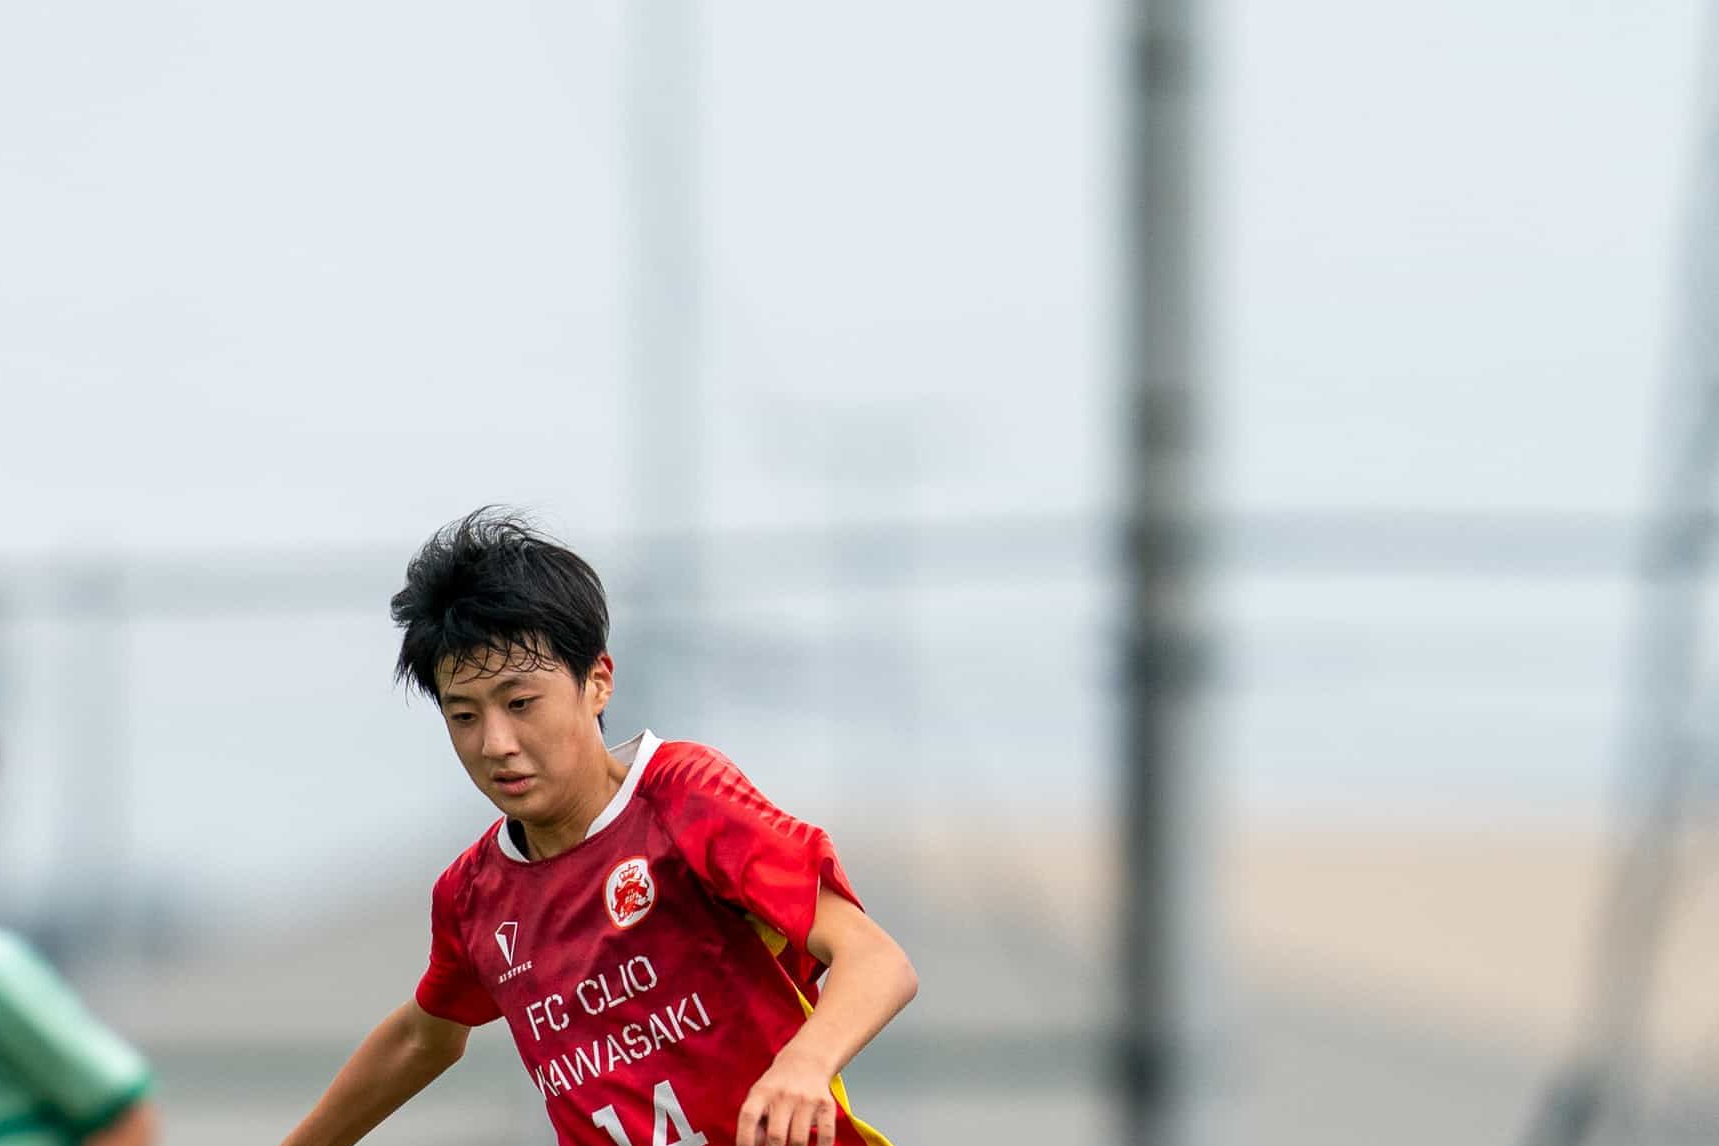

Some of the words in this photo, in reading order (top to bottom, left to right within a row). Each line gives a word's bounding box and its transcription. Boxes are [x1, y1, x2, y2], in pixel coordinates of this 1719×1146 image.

[526, 993, 570, 1041] FC
[575, 955, 658, 1016] CLIO
[535, 992, 712, 1097] KAWASAKI
